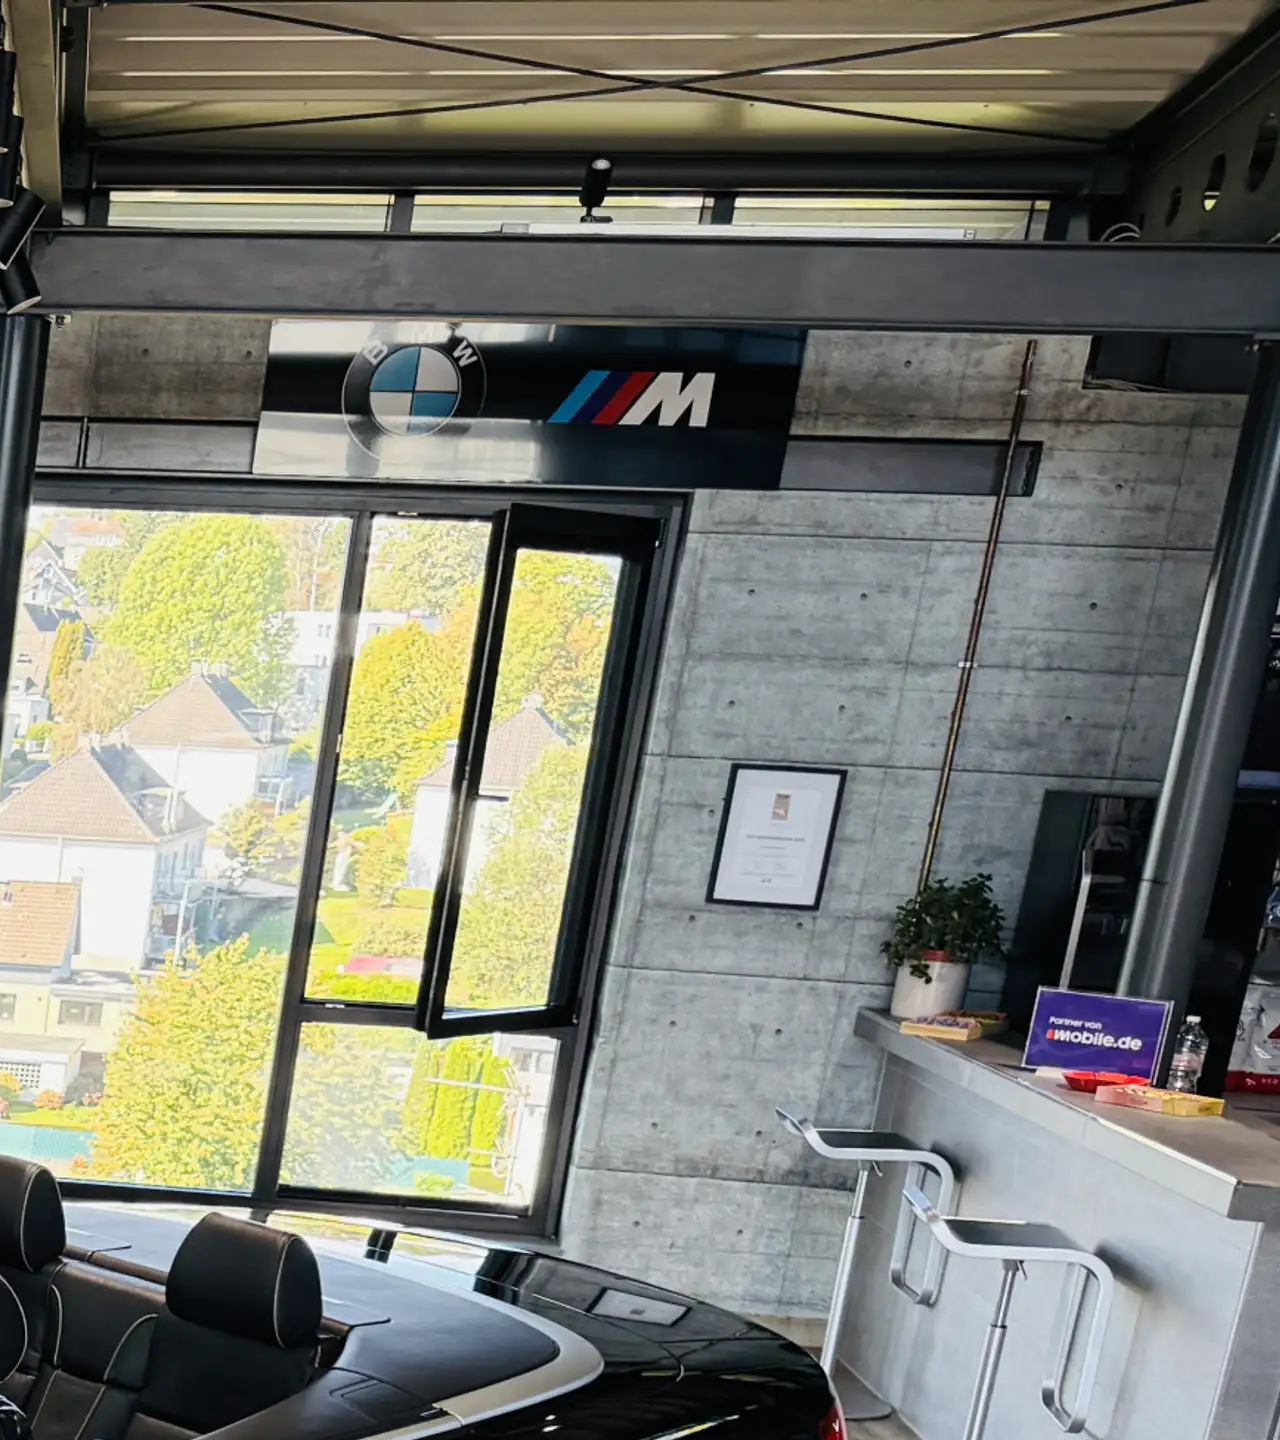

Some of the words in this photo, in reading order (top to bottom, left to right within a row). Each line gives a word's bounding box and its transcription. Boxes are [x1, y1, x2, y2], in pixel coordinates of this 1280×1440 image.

[1049, 1016, 1083, 1027] Partner
[1084, 1021, 1102, 1030] von
[1053, 1029, 1143, 1051] mobile.de
